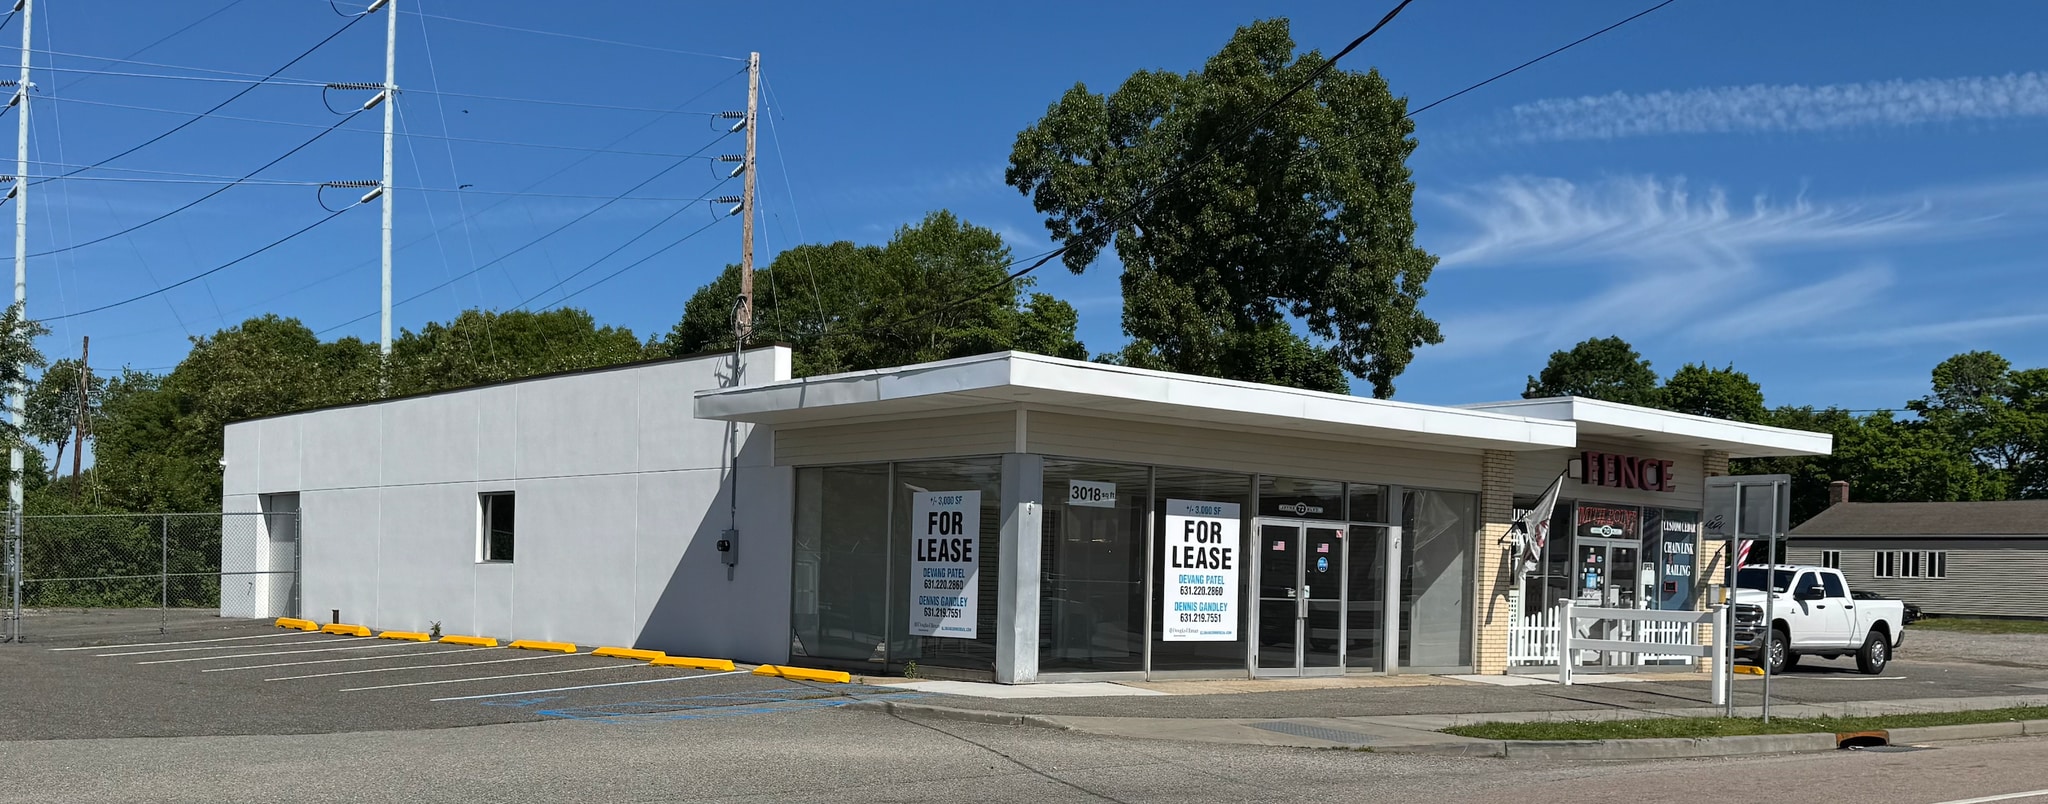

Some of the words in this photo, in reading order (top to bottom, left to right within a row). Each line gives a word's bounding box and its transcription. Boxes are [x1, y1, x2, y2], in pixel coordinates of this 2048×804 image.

[1581, 451, 1676, 492] FENCE
[1071, 485, 1101, 501] 3018
[955, 495, 963, 505] SF
[1213, 506, 1222, 515] SF
[928, 511, 963, 535] FOR
[1184, 520, 1222, 544] FOR
[917, 538, 972, 562] LEASE
[1664, 541, 1681, 554] CHAIN
[1681, 543, 1695, 555] LINK
[1172, 545, 1232, 570] LEASE
[923, 567, 946, 578] DEVANG
[947, 568, 965, 578] PATEL
[1665, 564, 1691, 577] RAILING
[923, 579, 964, 590] 631.220.2860
[1178, 574, 1204, 584] DEVANG
[1205, 575, 1225, 585] PATEL
[1180, 586, 1224, 596] 631.220.2860
[918, 595, 940, 606] DENNIS
[940, 596, 968, 607] GANDLEY
[923, 607, 962, 618] 631.219.7551
[1174, 602, 1198, 612] DENNIS
[1198, 602, 1228, 612] GANDLEY
[1180, 613, 1222, 623] 631.219.7551
